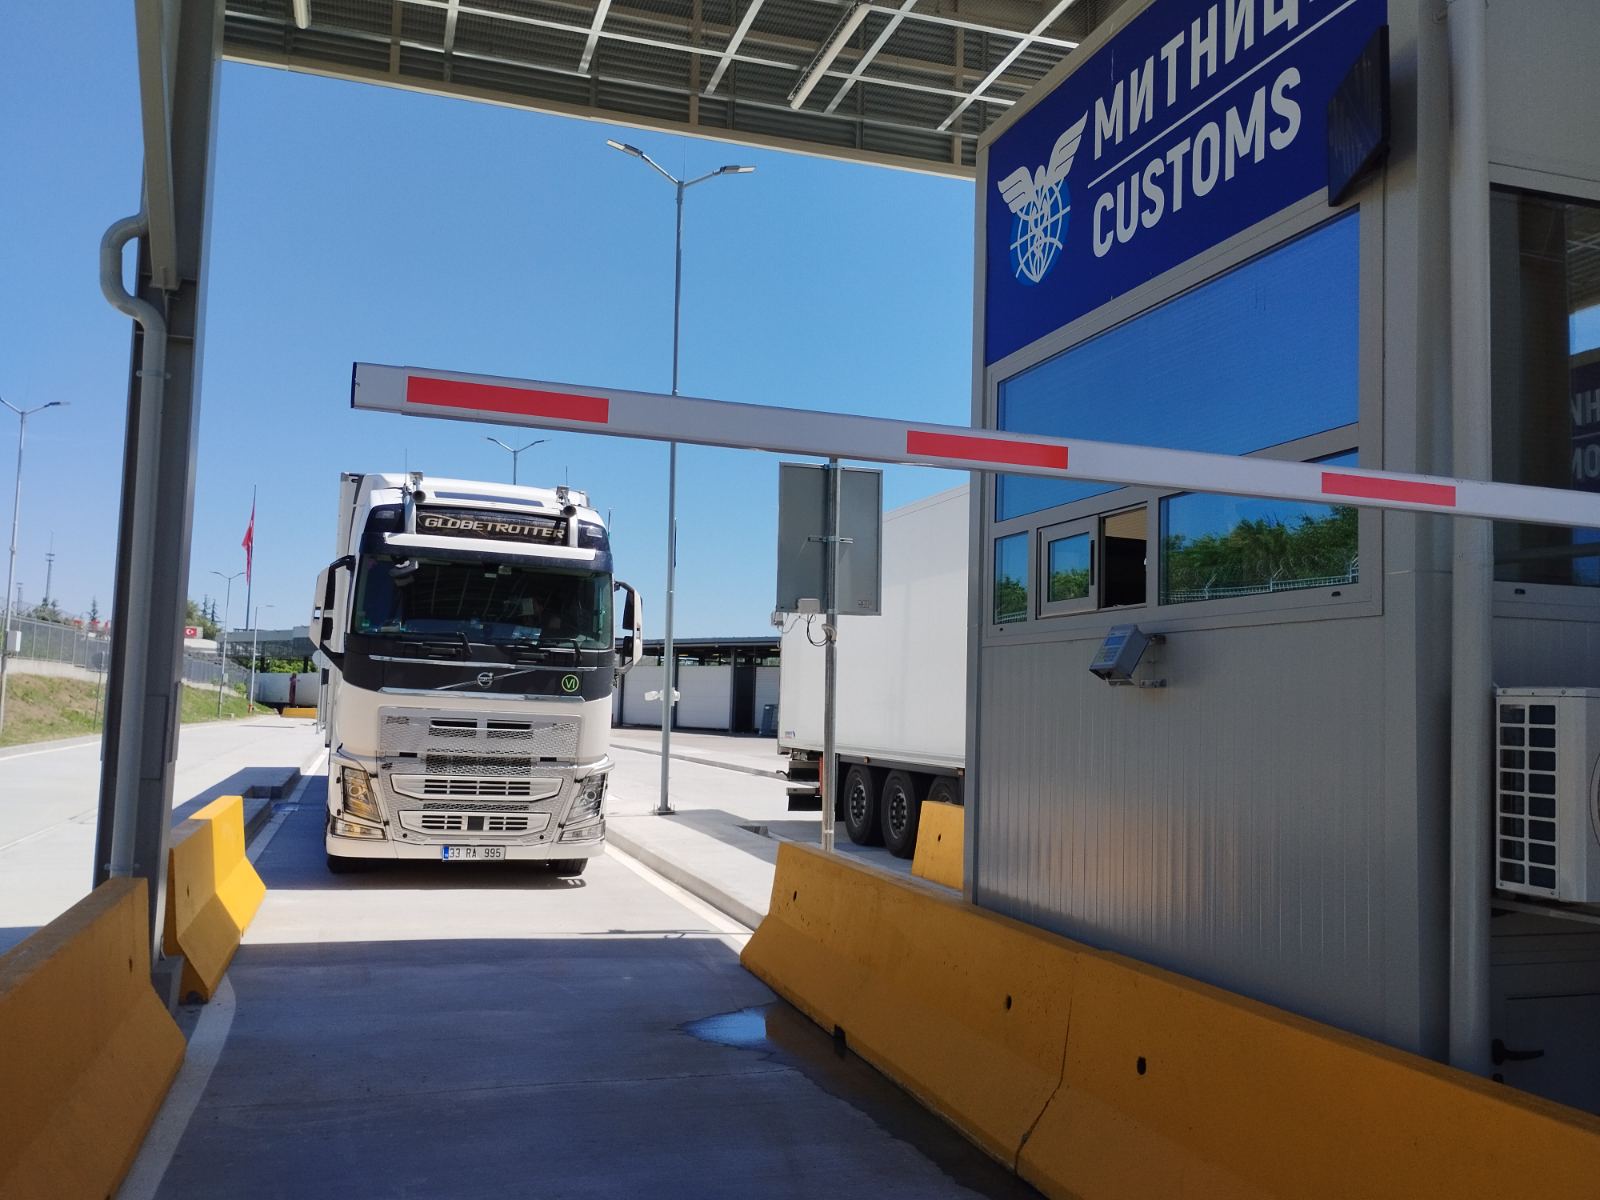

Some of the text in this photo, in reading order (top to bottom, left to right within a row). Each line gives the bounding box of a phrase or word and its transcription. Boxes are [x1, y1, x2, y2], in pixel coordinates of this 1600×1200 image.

[1094, 0, 1315, 160] МИТНИ
[1093, 67, 1302, 258] CUSTOMS
[424, 517, 565, 539] GLOBETROTTER
[450, 848, 501, 858] 33 RA 995
